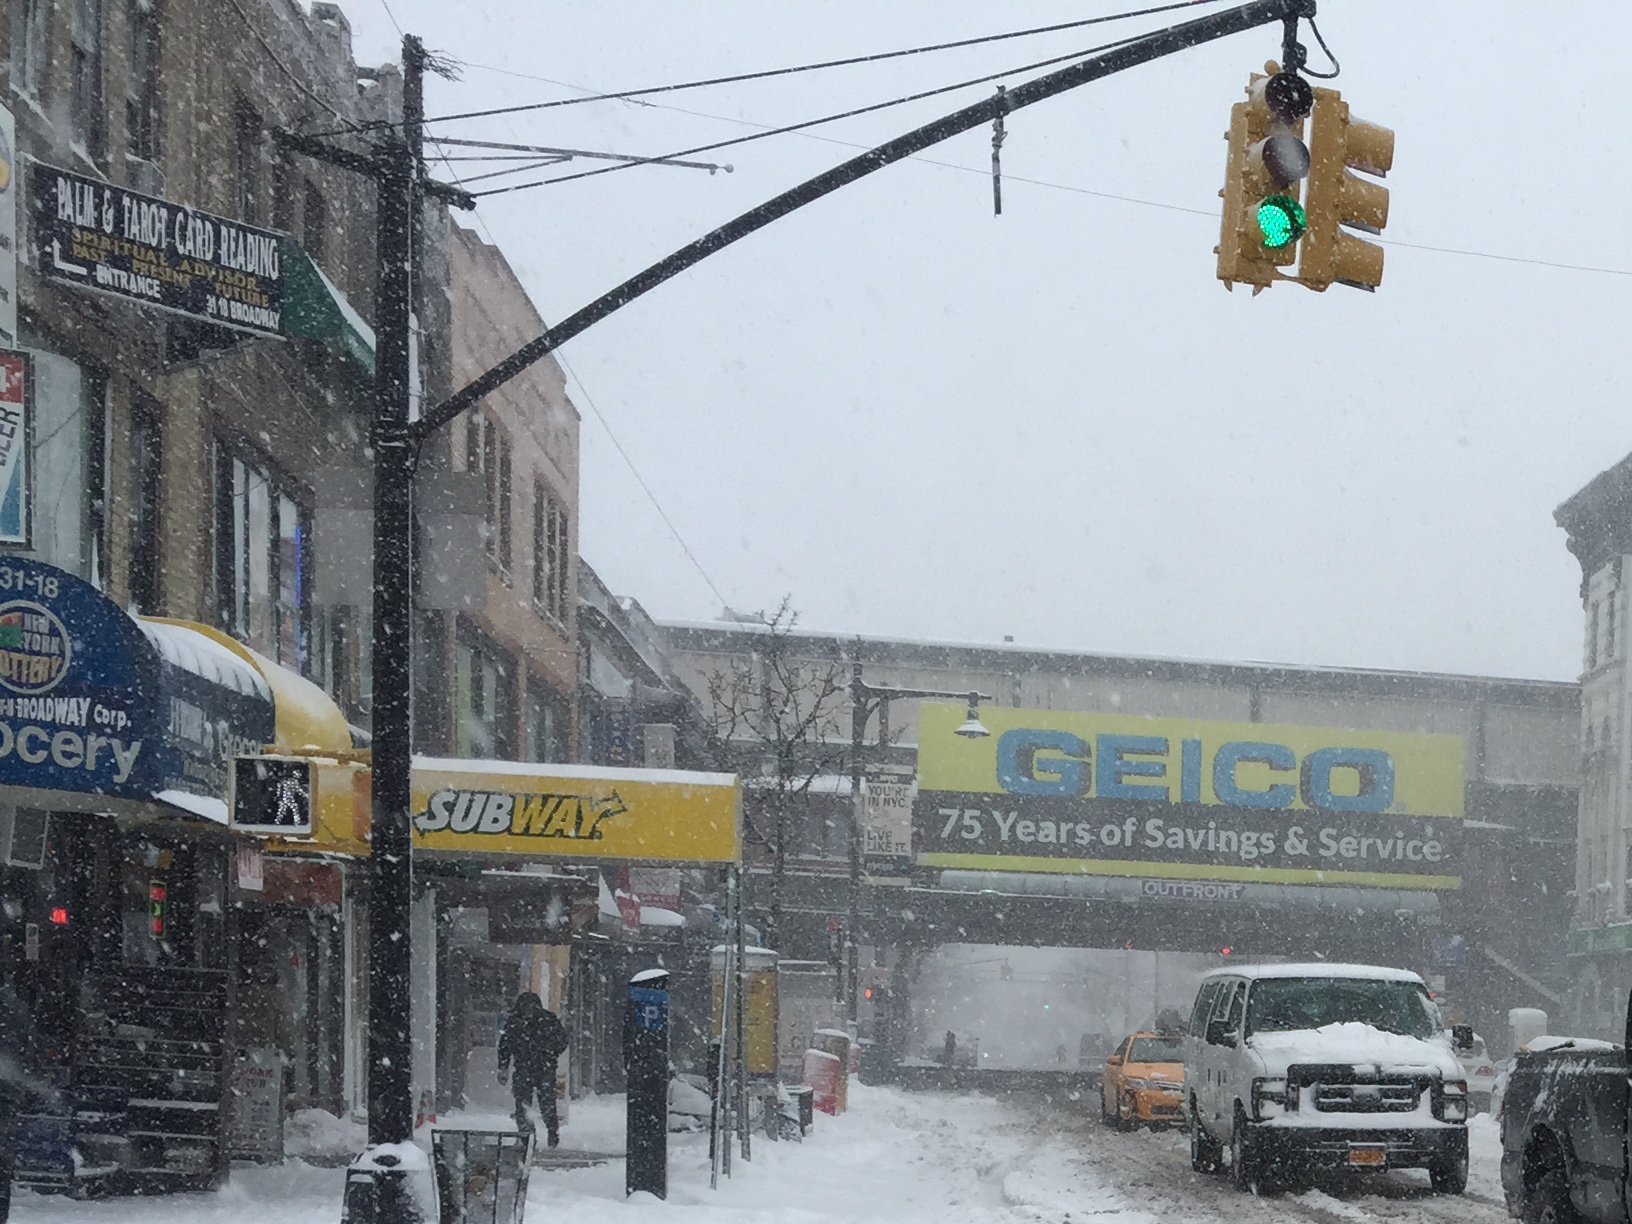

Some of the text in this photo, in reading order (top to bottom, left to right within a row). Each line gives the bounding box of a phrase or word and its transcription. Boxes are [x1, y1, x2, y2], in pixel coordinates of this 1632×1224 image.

[57, 176, 280, 280] PALM & TAROT CARD READING
[72, 228, 261, 293] SPIRITUAL ADVISOR
[72, 243, 270, 308] PAST PRESENT FUTURE
[96, 263, 161, 299] ENTRANCE
[229, 300, 281, 331] BROADWAY
[0, 567, 59, 599] 31-18
[22, 631, 62, 655] YORK
[0, 650, 63, 685] OTTERY
[16, 697, 91, 727] BROADWAY
[94, 703, 132, 732] Corp.
[0, 720, 142, 784] cery
[996, 727, 1395, 814] GEICO
[867, 785, 911, 797] YOU'RE
[867, 797, 880, 807] IN
[413, 789, 628, 840] SUBWAY
[866, 841, 893, 853] LIKE
[938, 808, 1443, 863] 75 Years of Savings & Service
[1144, 881, 1242, 900] OUTFRONT
[643, 1005, 659, 1028] P
